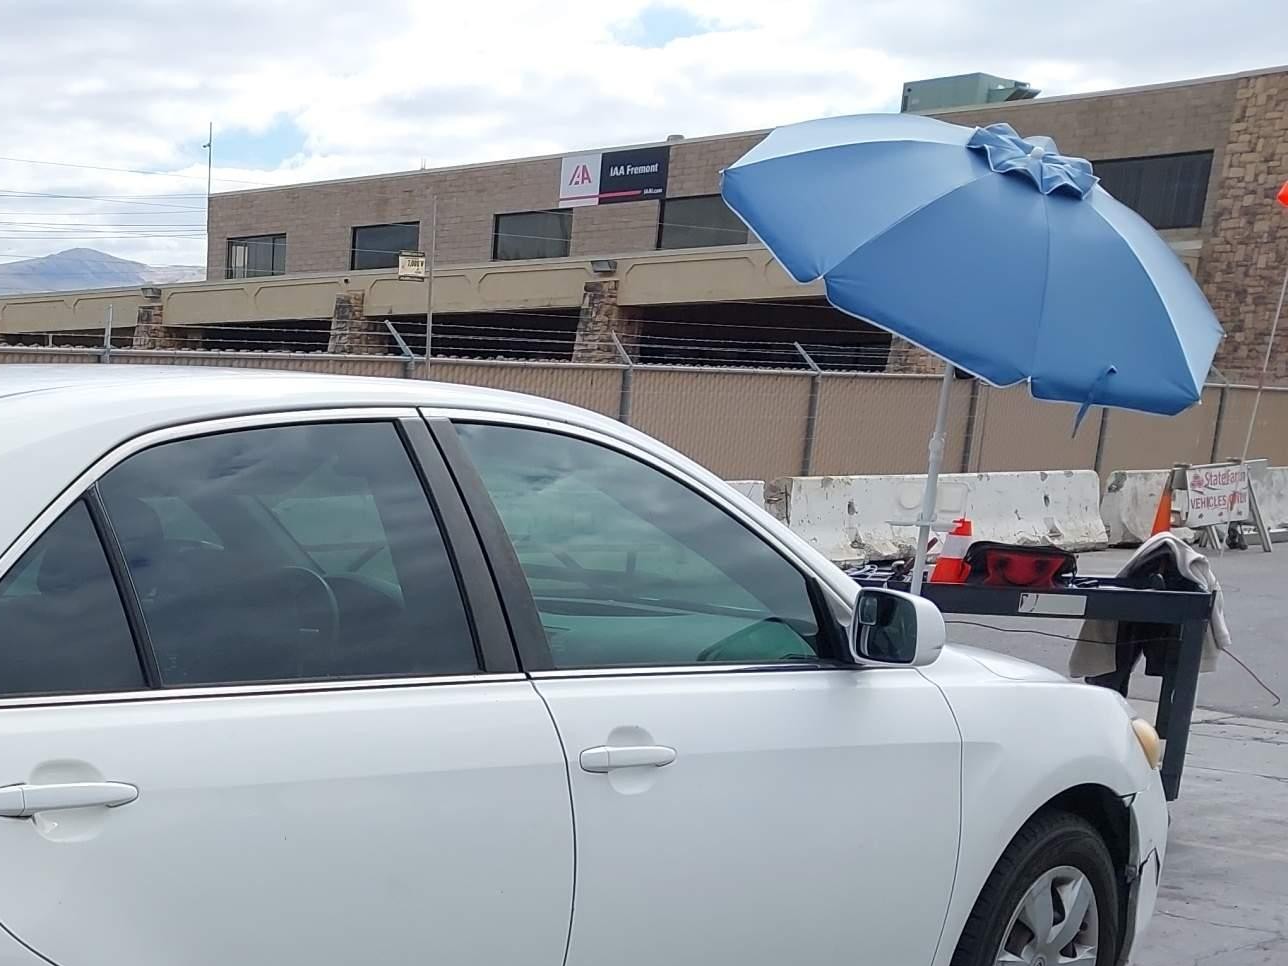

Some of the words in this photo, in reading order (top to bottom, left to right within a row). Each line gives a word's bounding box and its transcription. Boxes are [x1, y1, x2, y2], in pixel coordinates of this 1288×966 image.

[610, 165, 625, 177] IAA
[626, 162, 659, 175] Fremont
[1191, 495, 1227, 510] VEHICLES
